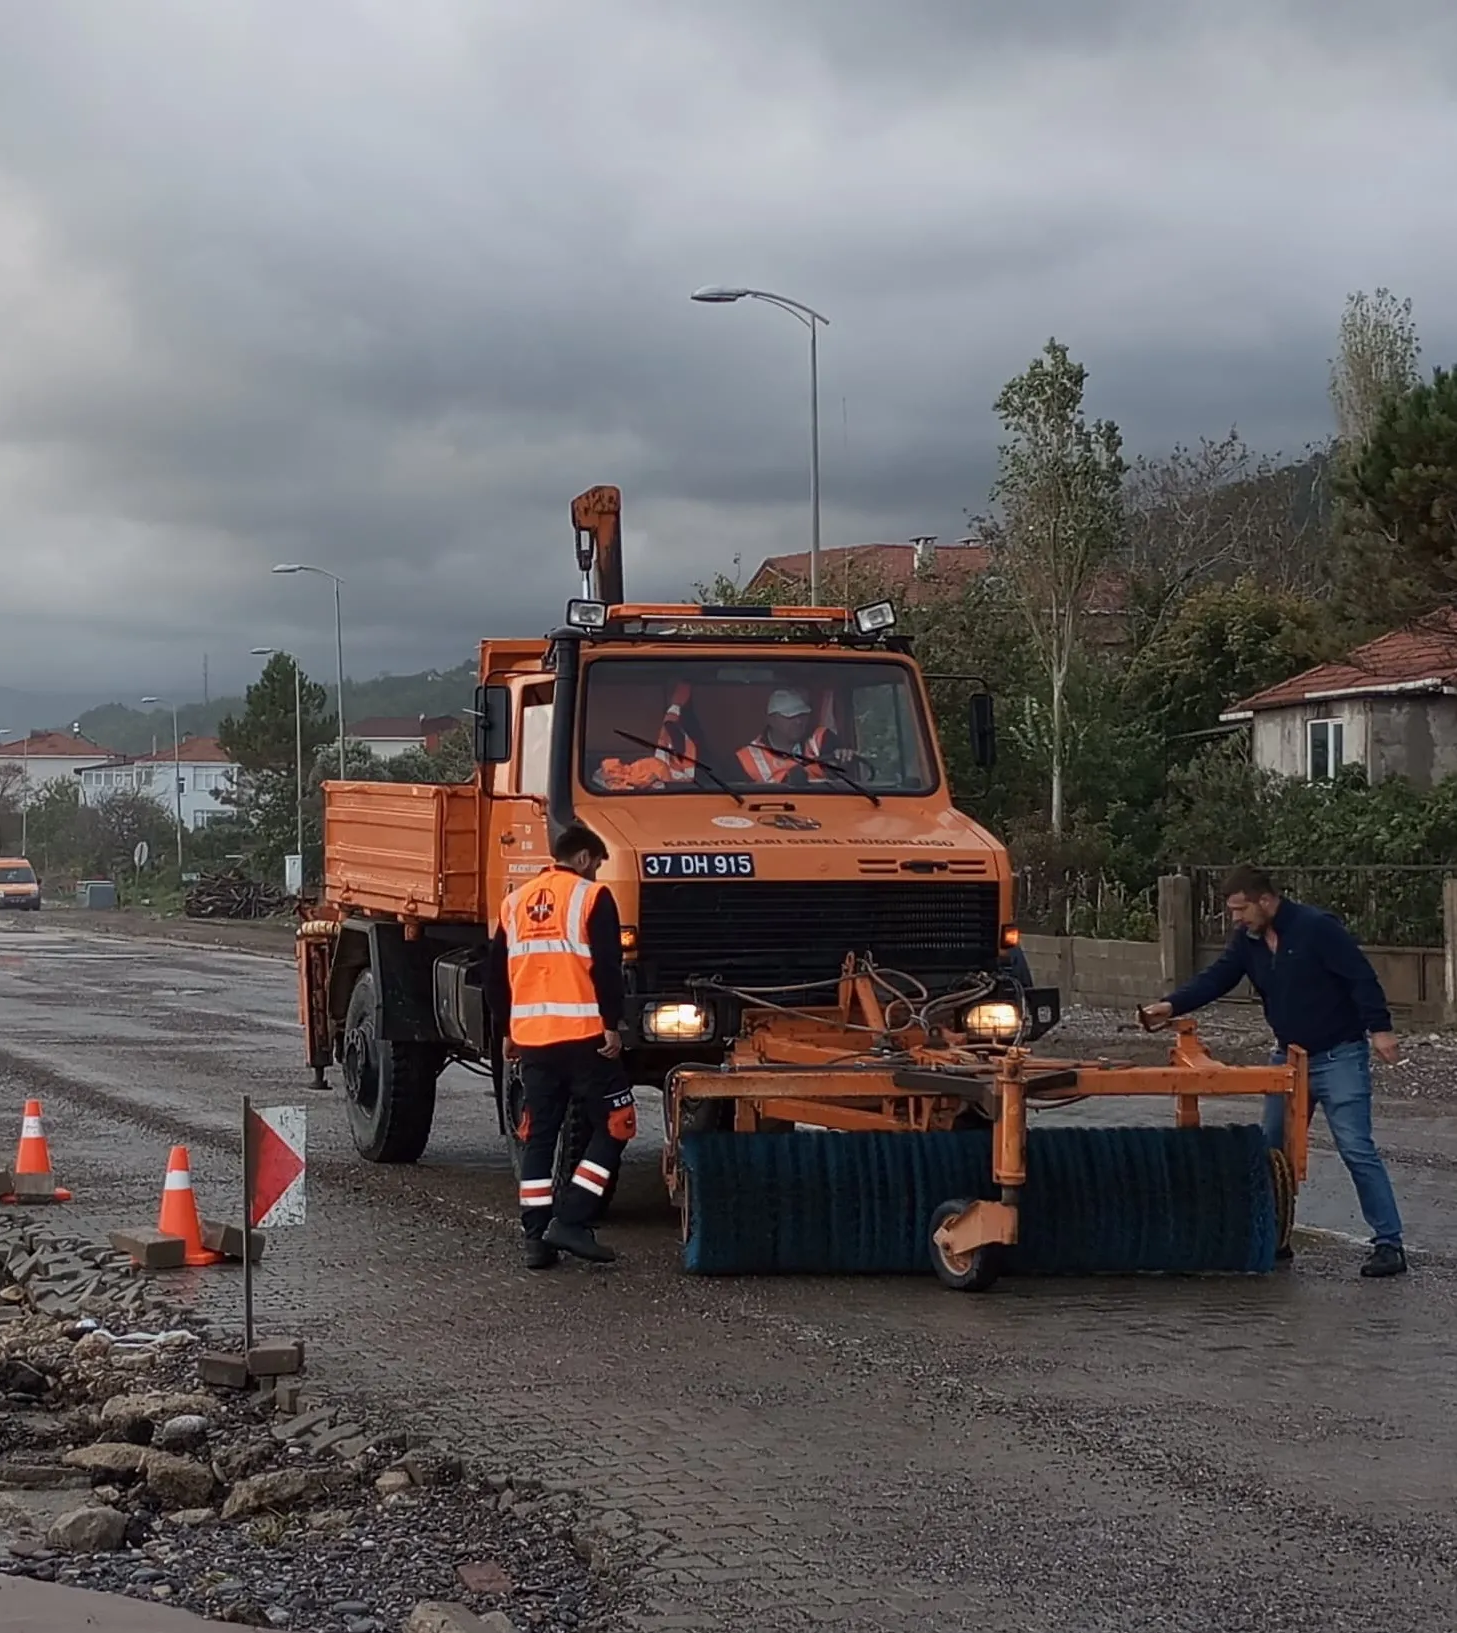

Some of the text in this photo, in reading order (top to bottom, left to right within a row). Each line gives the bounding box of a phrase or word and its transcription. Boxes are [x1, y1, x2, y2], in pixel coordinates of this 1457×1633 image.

[786, 838, 845, 846] GENEL
[646, 855, 751, 874] 37 DH 915
